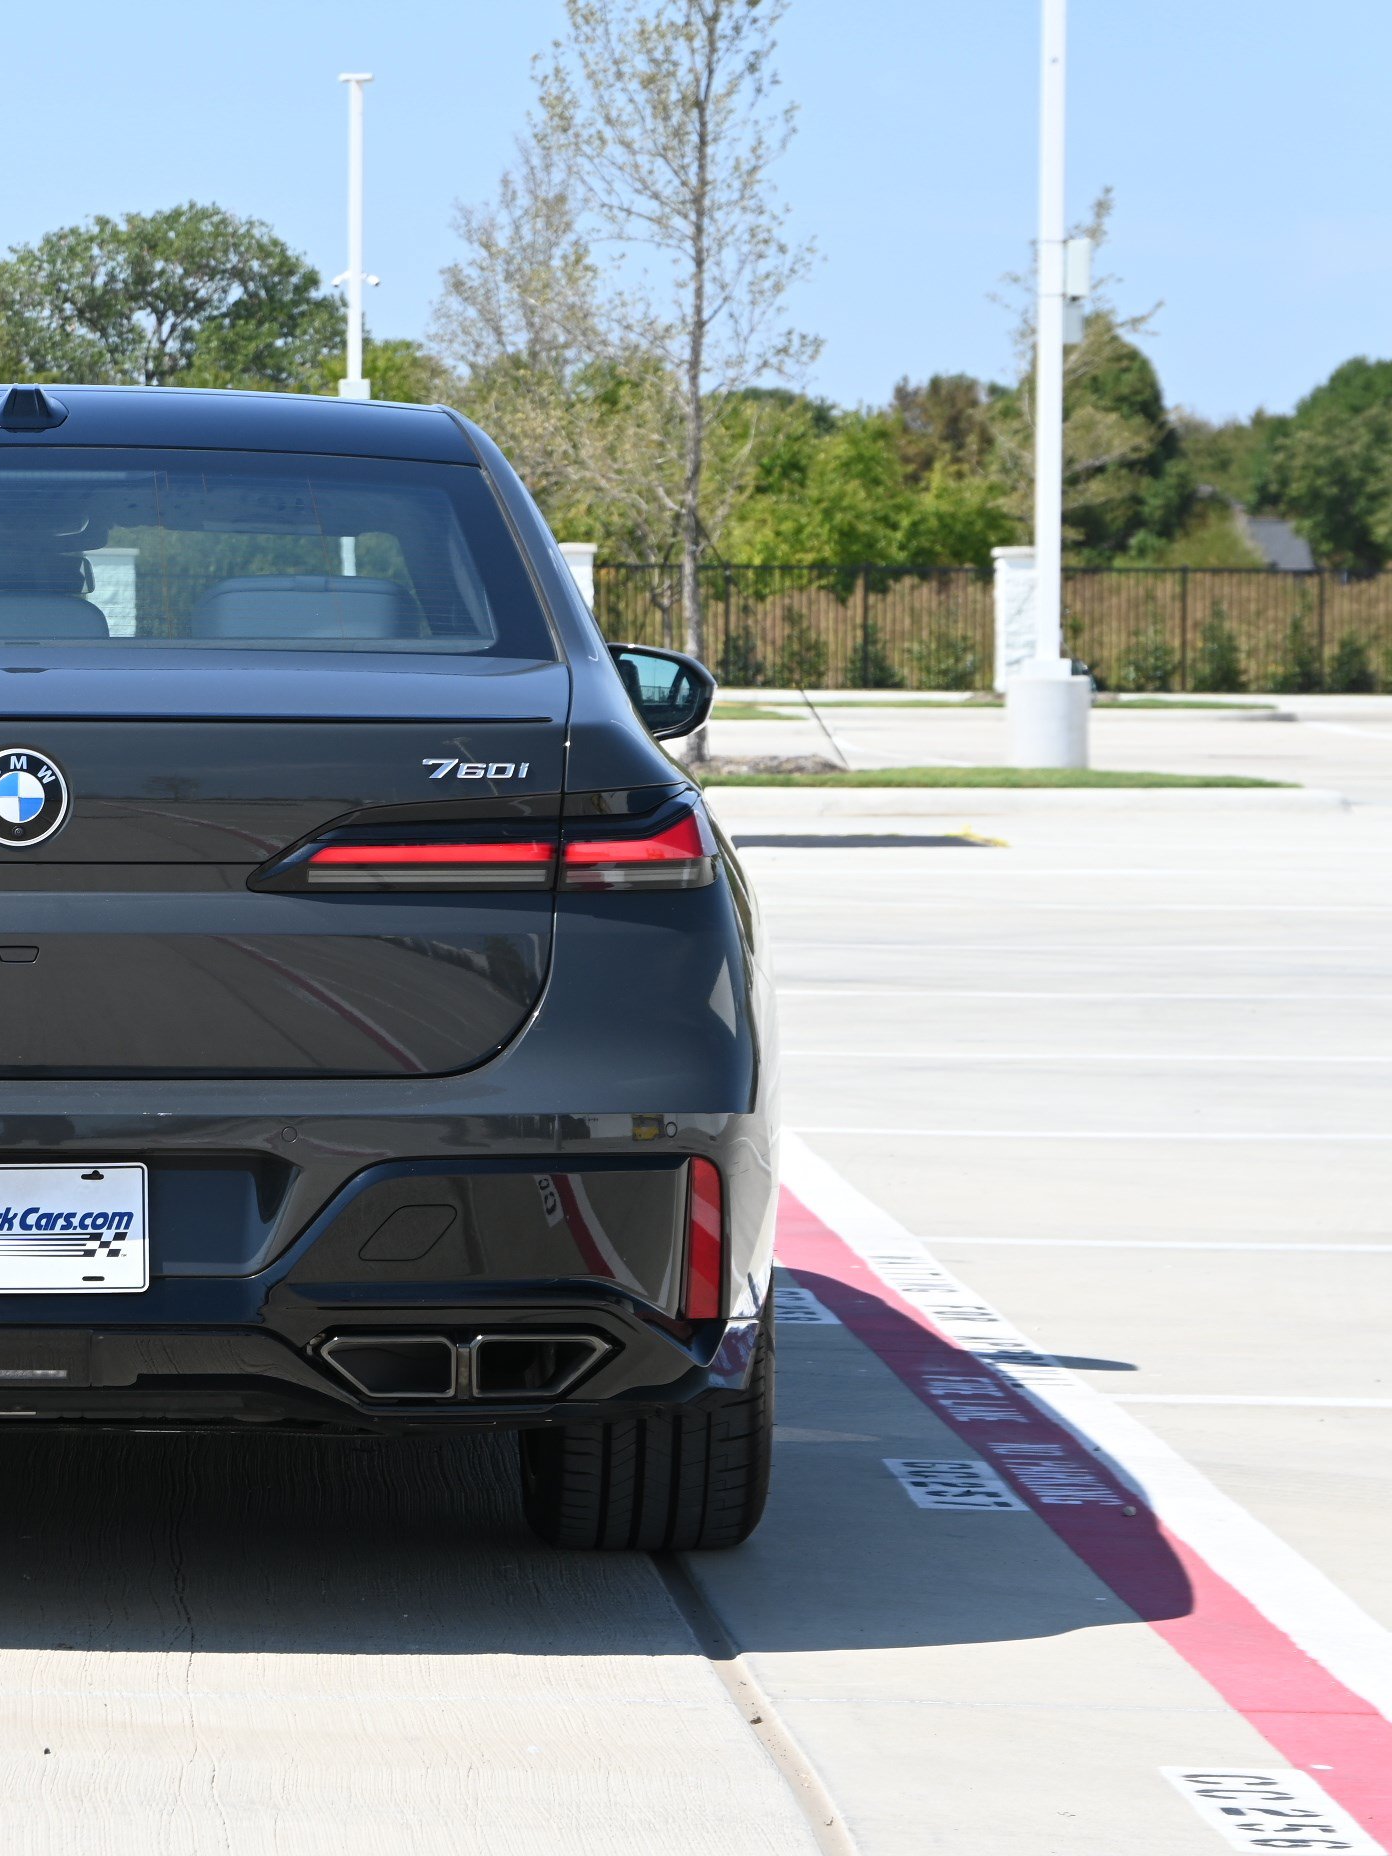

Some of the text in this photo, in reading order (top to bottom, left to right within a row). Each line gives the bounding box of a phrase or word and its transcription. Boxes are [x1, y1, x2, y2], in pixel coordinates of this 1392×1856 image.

[925, 1303, 999, 1323] FOR
[921, 1375, 1124, 1505] FIRE LANE NO PARKING
[901, 1461, 1013, 1508] CC257
[1180, 1773, 1353, 1849] CC256
